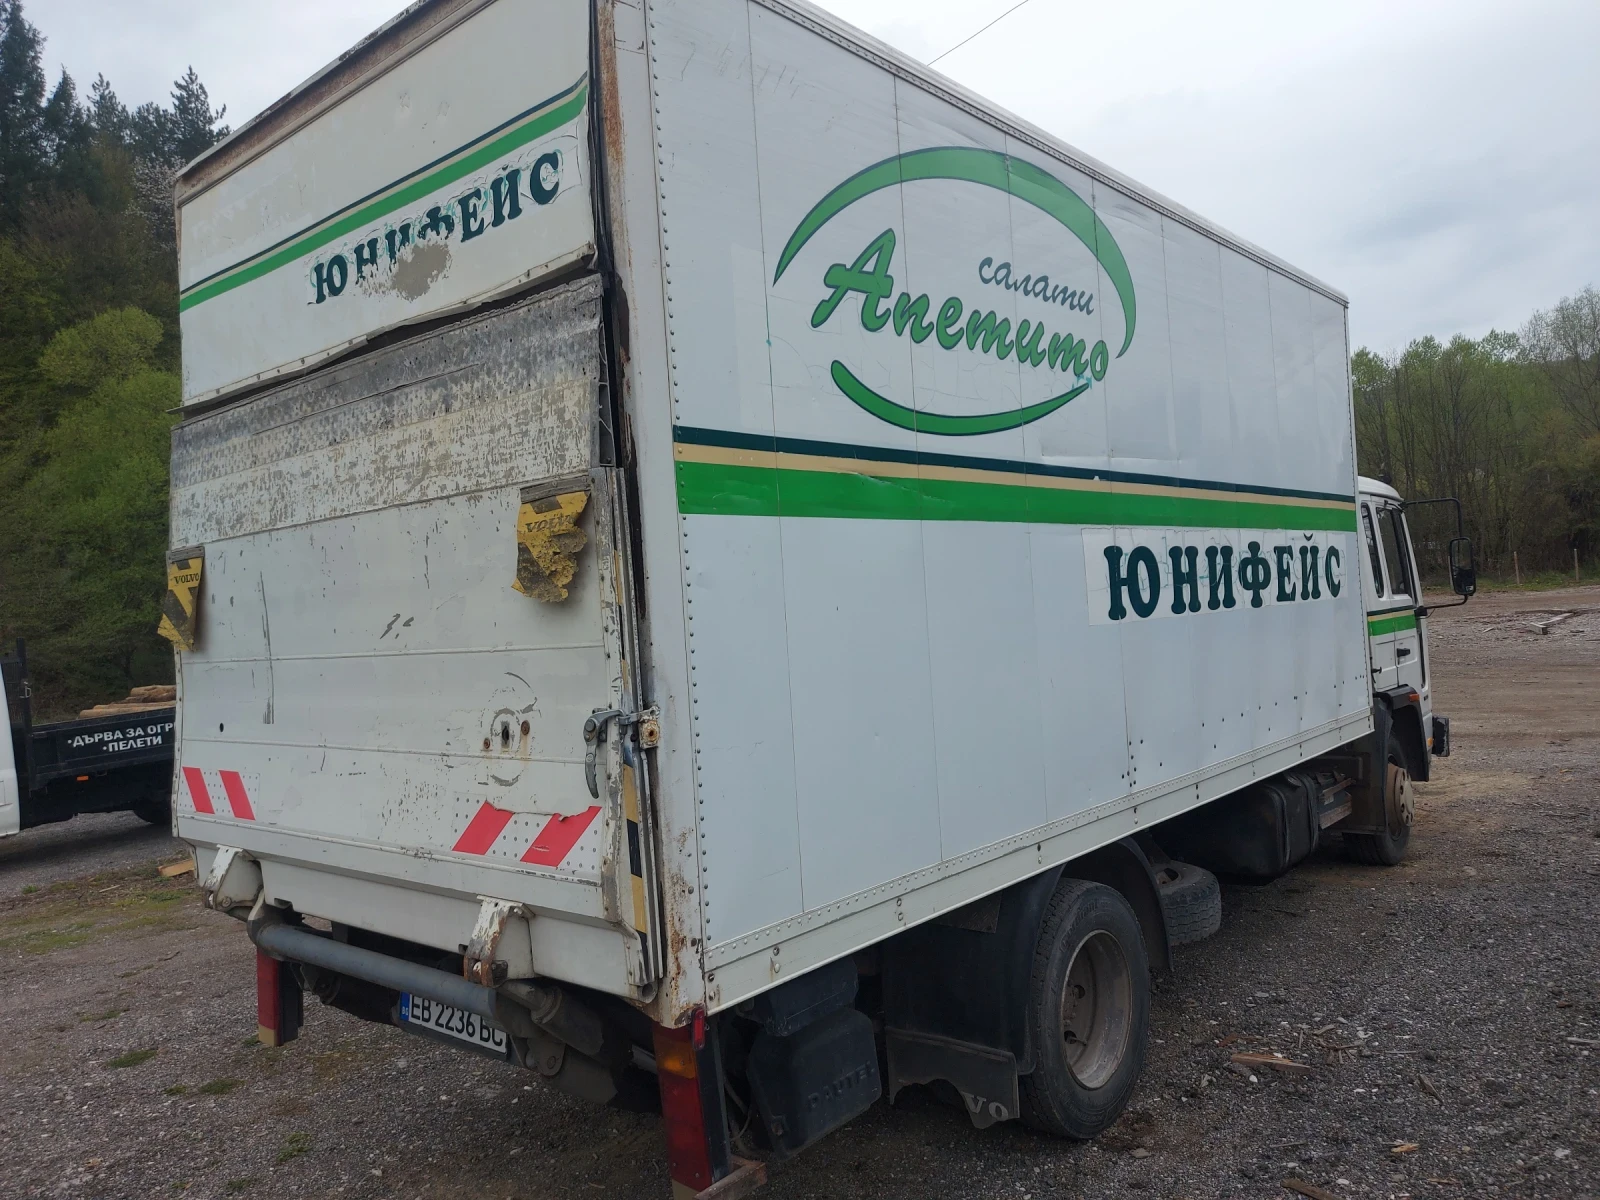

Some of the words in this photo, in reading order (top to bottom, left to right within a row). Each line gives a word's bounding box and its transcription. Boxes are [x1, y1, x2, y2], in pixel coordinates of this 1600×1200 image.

[810, 228, 1109, 382] Апетито
[978, 256, 1094, 315] салати
[173, 572, 200, 585] VOLVO
[1103, 532, 1341, 621] ЮНИФЕЙС
[126, 727, 145, 738] ЗА
[147, 722, 176, 734] ОГР
[435, 1002, 476, 1038] 2236
